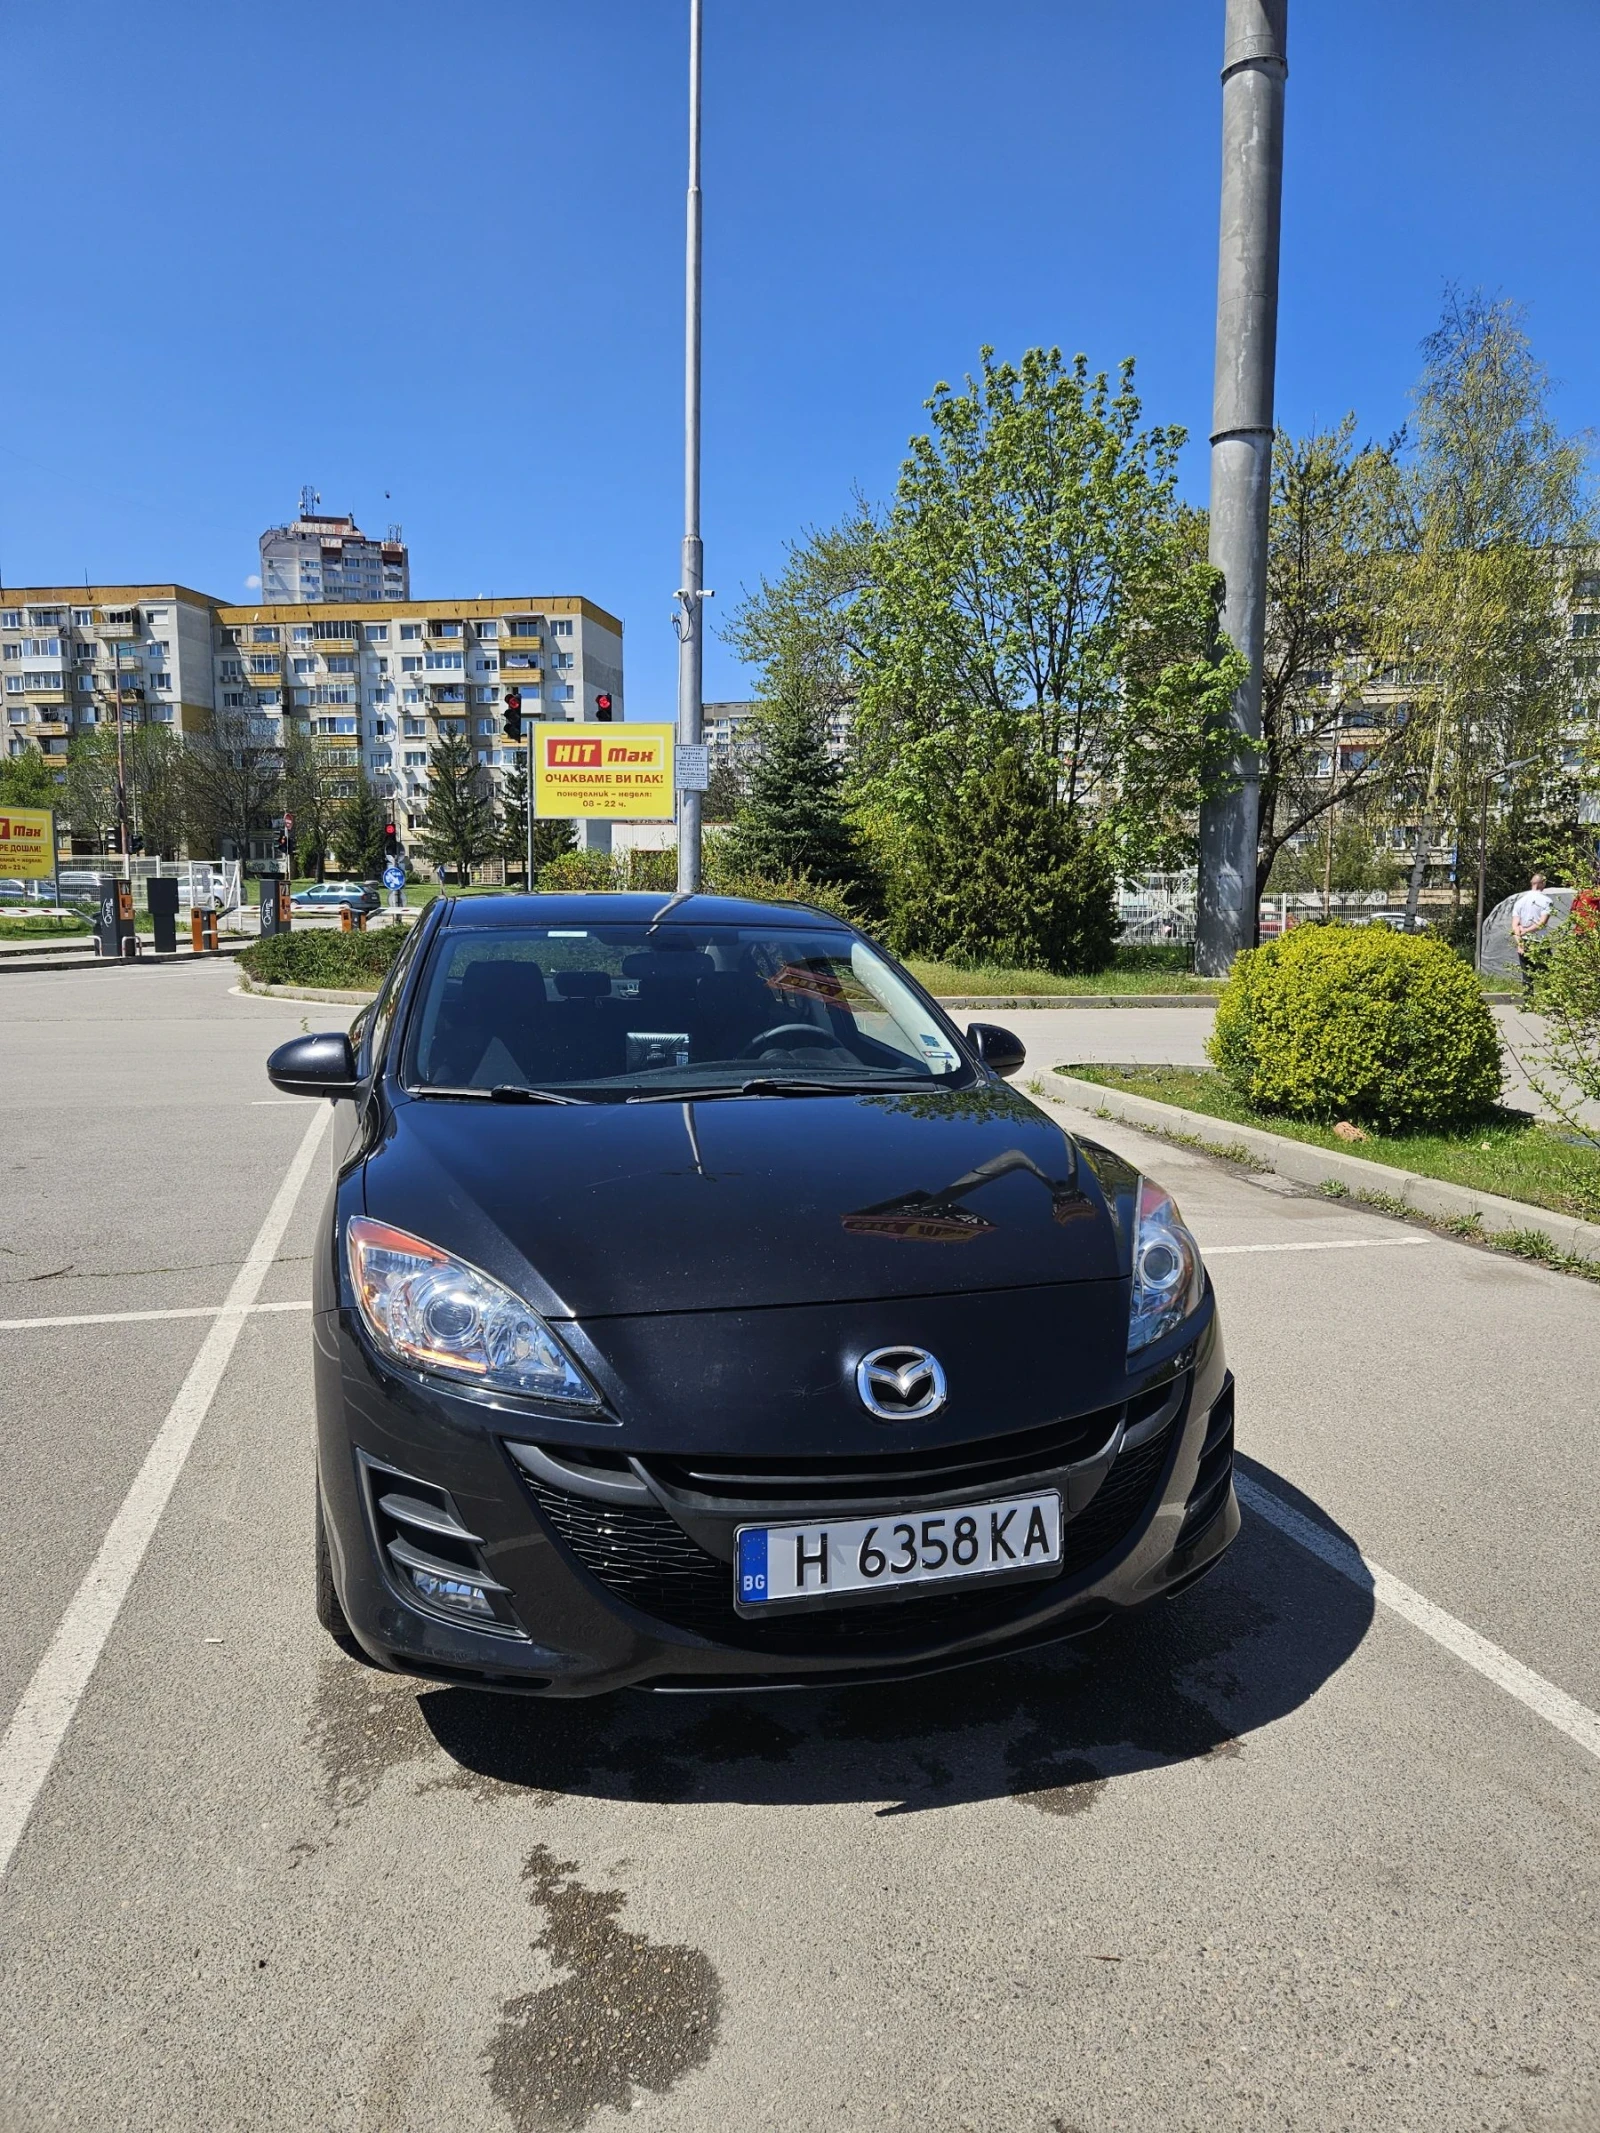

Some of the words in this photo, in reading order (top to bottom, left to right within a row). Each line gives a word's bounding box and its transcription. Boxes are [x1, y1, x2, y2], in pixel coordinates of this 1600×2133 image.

[554, 744, 596, 763] HIT
[545, 774, 612, 784] ОЧАКВАМЕ
[615, 774, 632, 784] ВИ
[634, 774, 664, 784] ПАК!
[556, 790, 609, 798] понеделник
[604, 800, 616, 808] 22
[10, 844, 41, 853] ДОШЛИ!
[795, 1531, 829, 1588] H
[857, 1516, 979, 1578] 6358
[990, 1505, 1050, 1562] KA
[742, 1574, 766, 1591] BG
